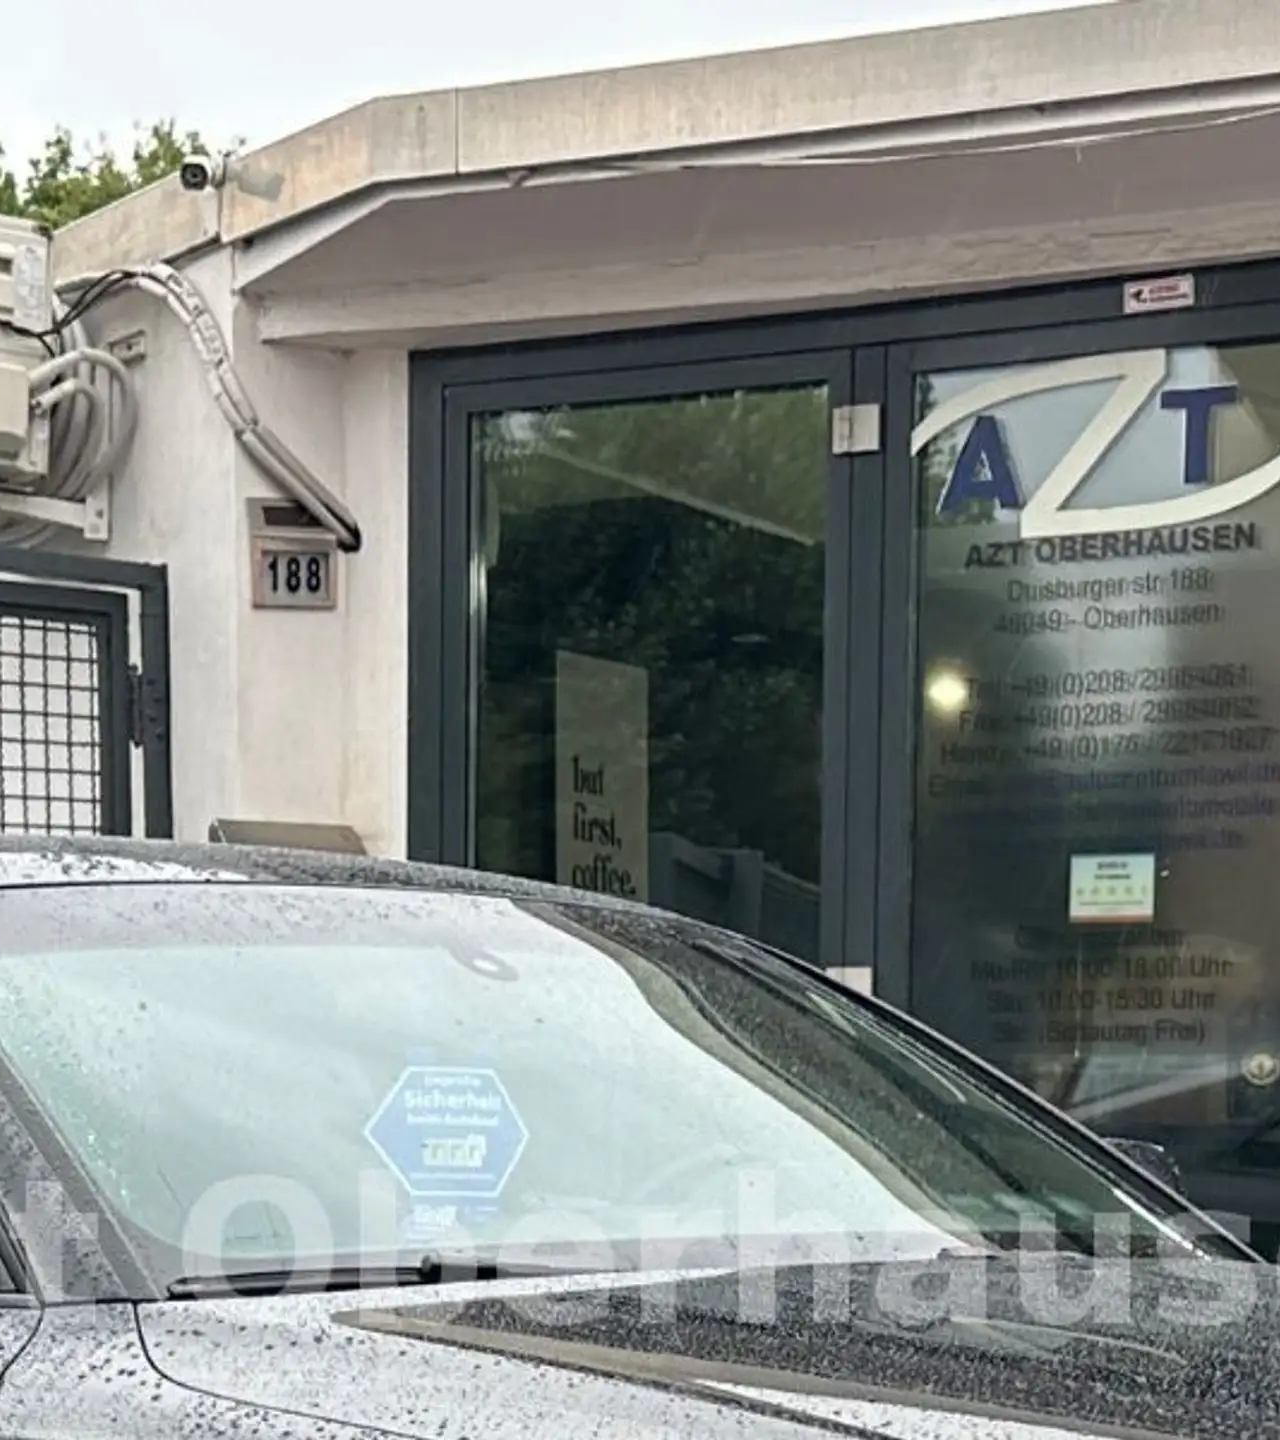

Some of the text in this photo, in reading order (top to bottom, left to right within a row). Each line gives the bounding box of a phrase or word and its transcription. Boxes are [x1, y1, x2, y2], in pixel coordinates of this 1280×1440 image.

[964, 521, 1257, 570] AZT OBERHAUSEN
[268, 555, 321, 593] 188
[571, 754, 604, 796] but
[572, 801, 623, 850] first,
